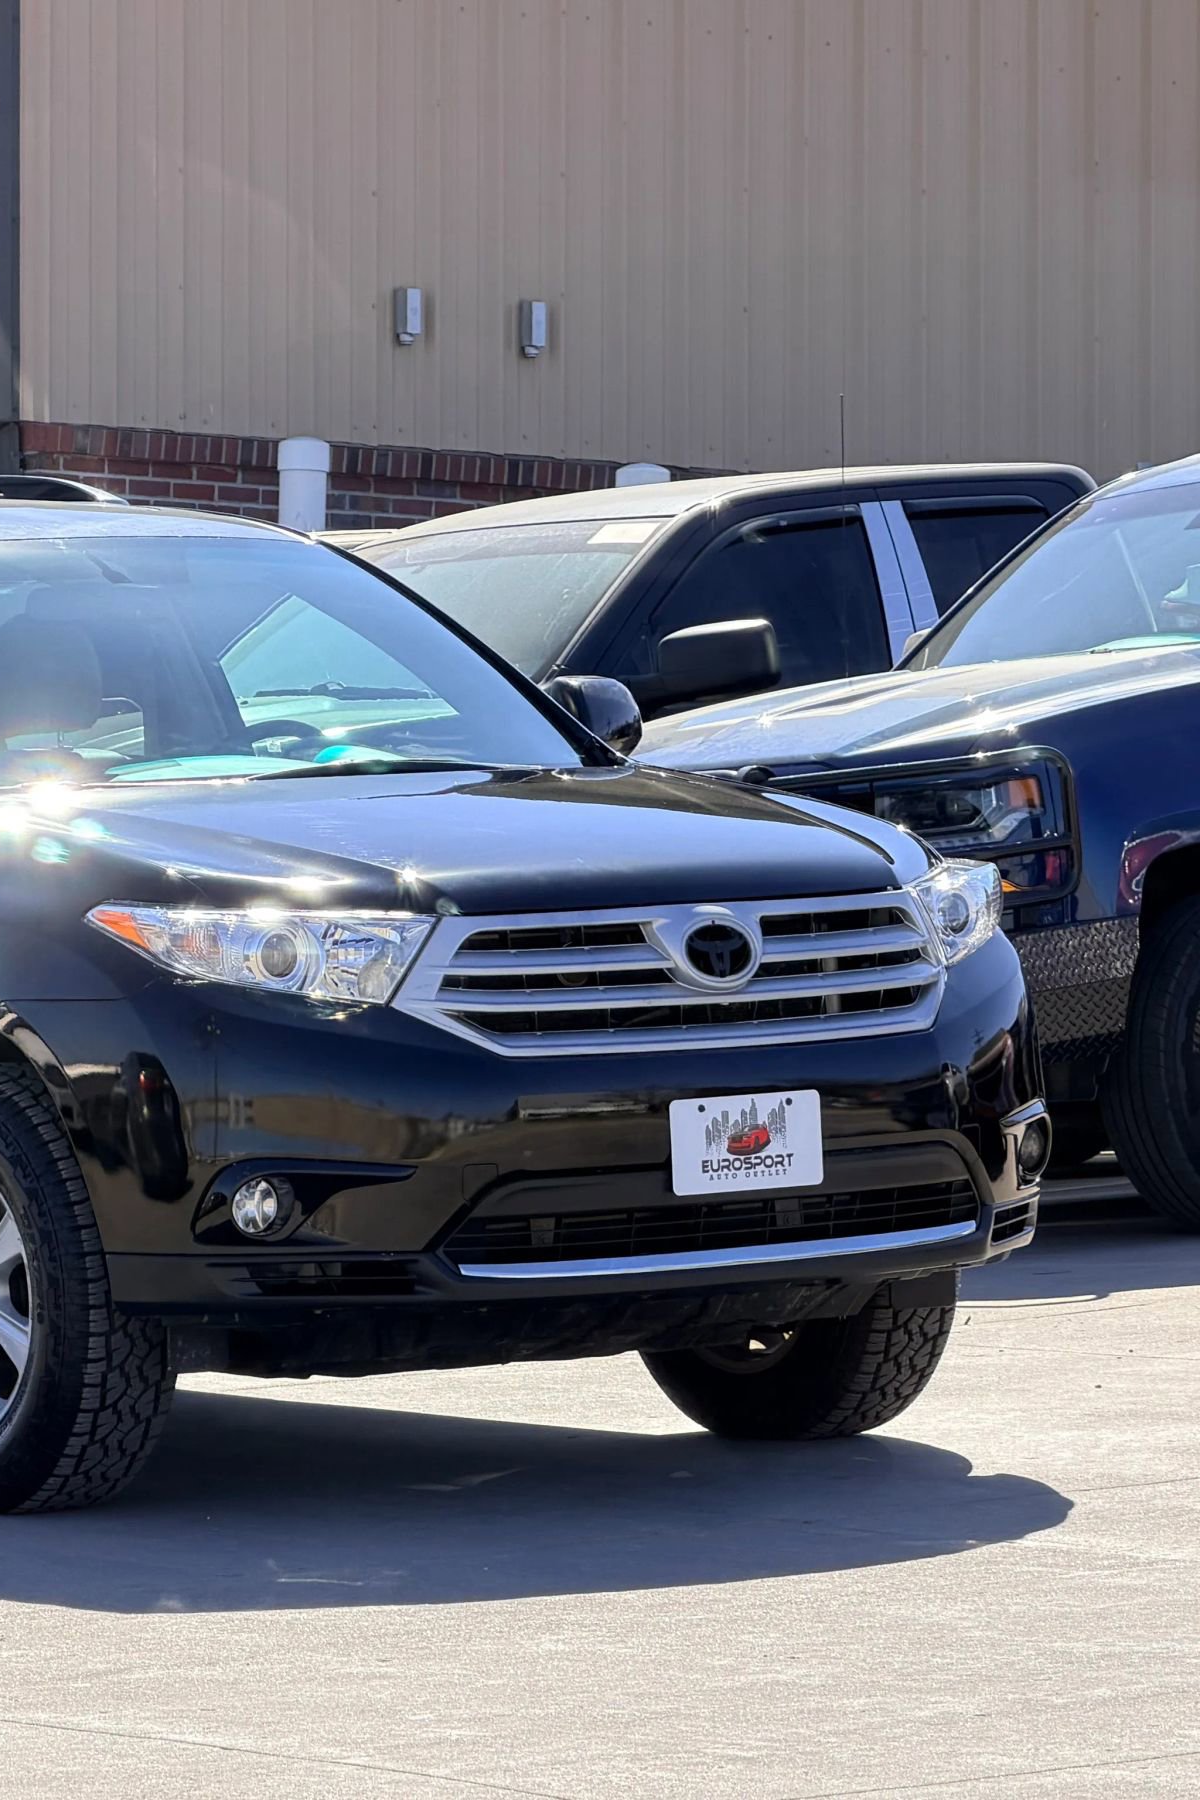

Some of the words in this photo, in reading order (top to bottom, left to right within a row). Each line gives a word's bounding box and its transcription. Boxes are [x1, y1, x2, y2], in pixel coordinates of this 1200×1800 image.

[702, 1153, 794, 1174] EUROSPORT
[709, 1173, 738, 1181] AUTO
[745, 1169, 787, 1178] OUTLET
